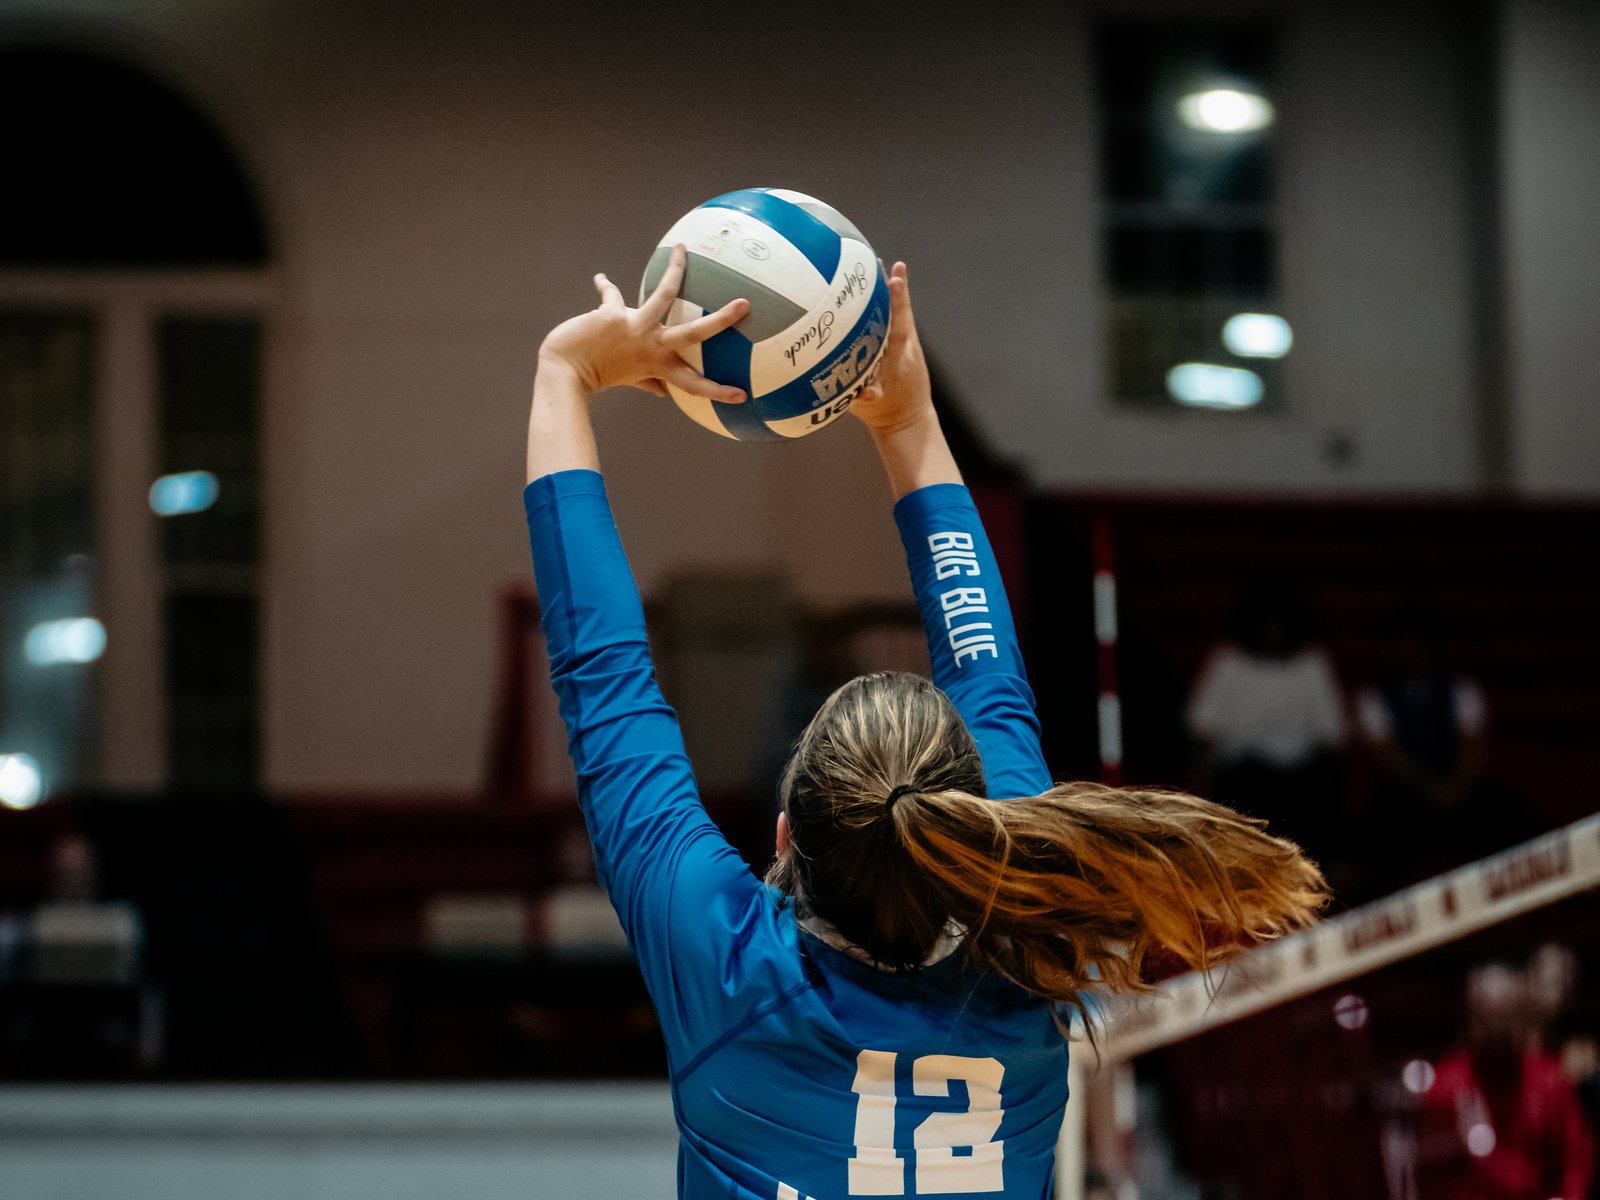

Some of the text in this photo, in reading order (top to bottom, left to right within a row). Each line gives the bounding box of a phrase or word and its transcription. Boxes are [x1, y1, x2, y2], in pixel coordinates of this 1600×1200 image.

[836, 262, 868, 308] Super
[784, 311, 834, 367] Touch
[811, 304, 887, 402] NCAA
[928, 531, 998, 668] BIG BLUE
[848, 1049, 1005, 1195] 12
